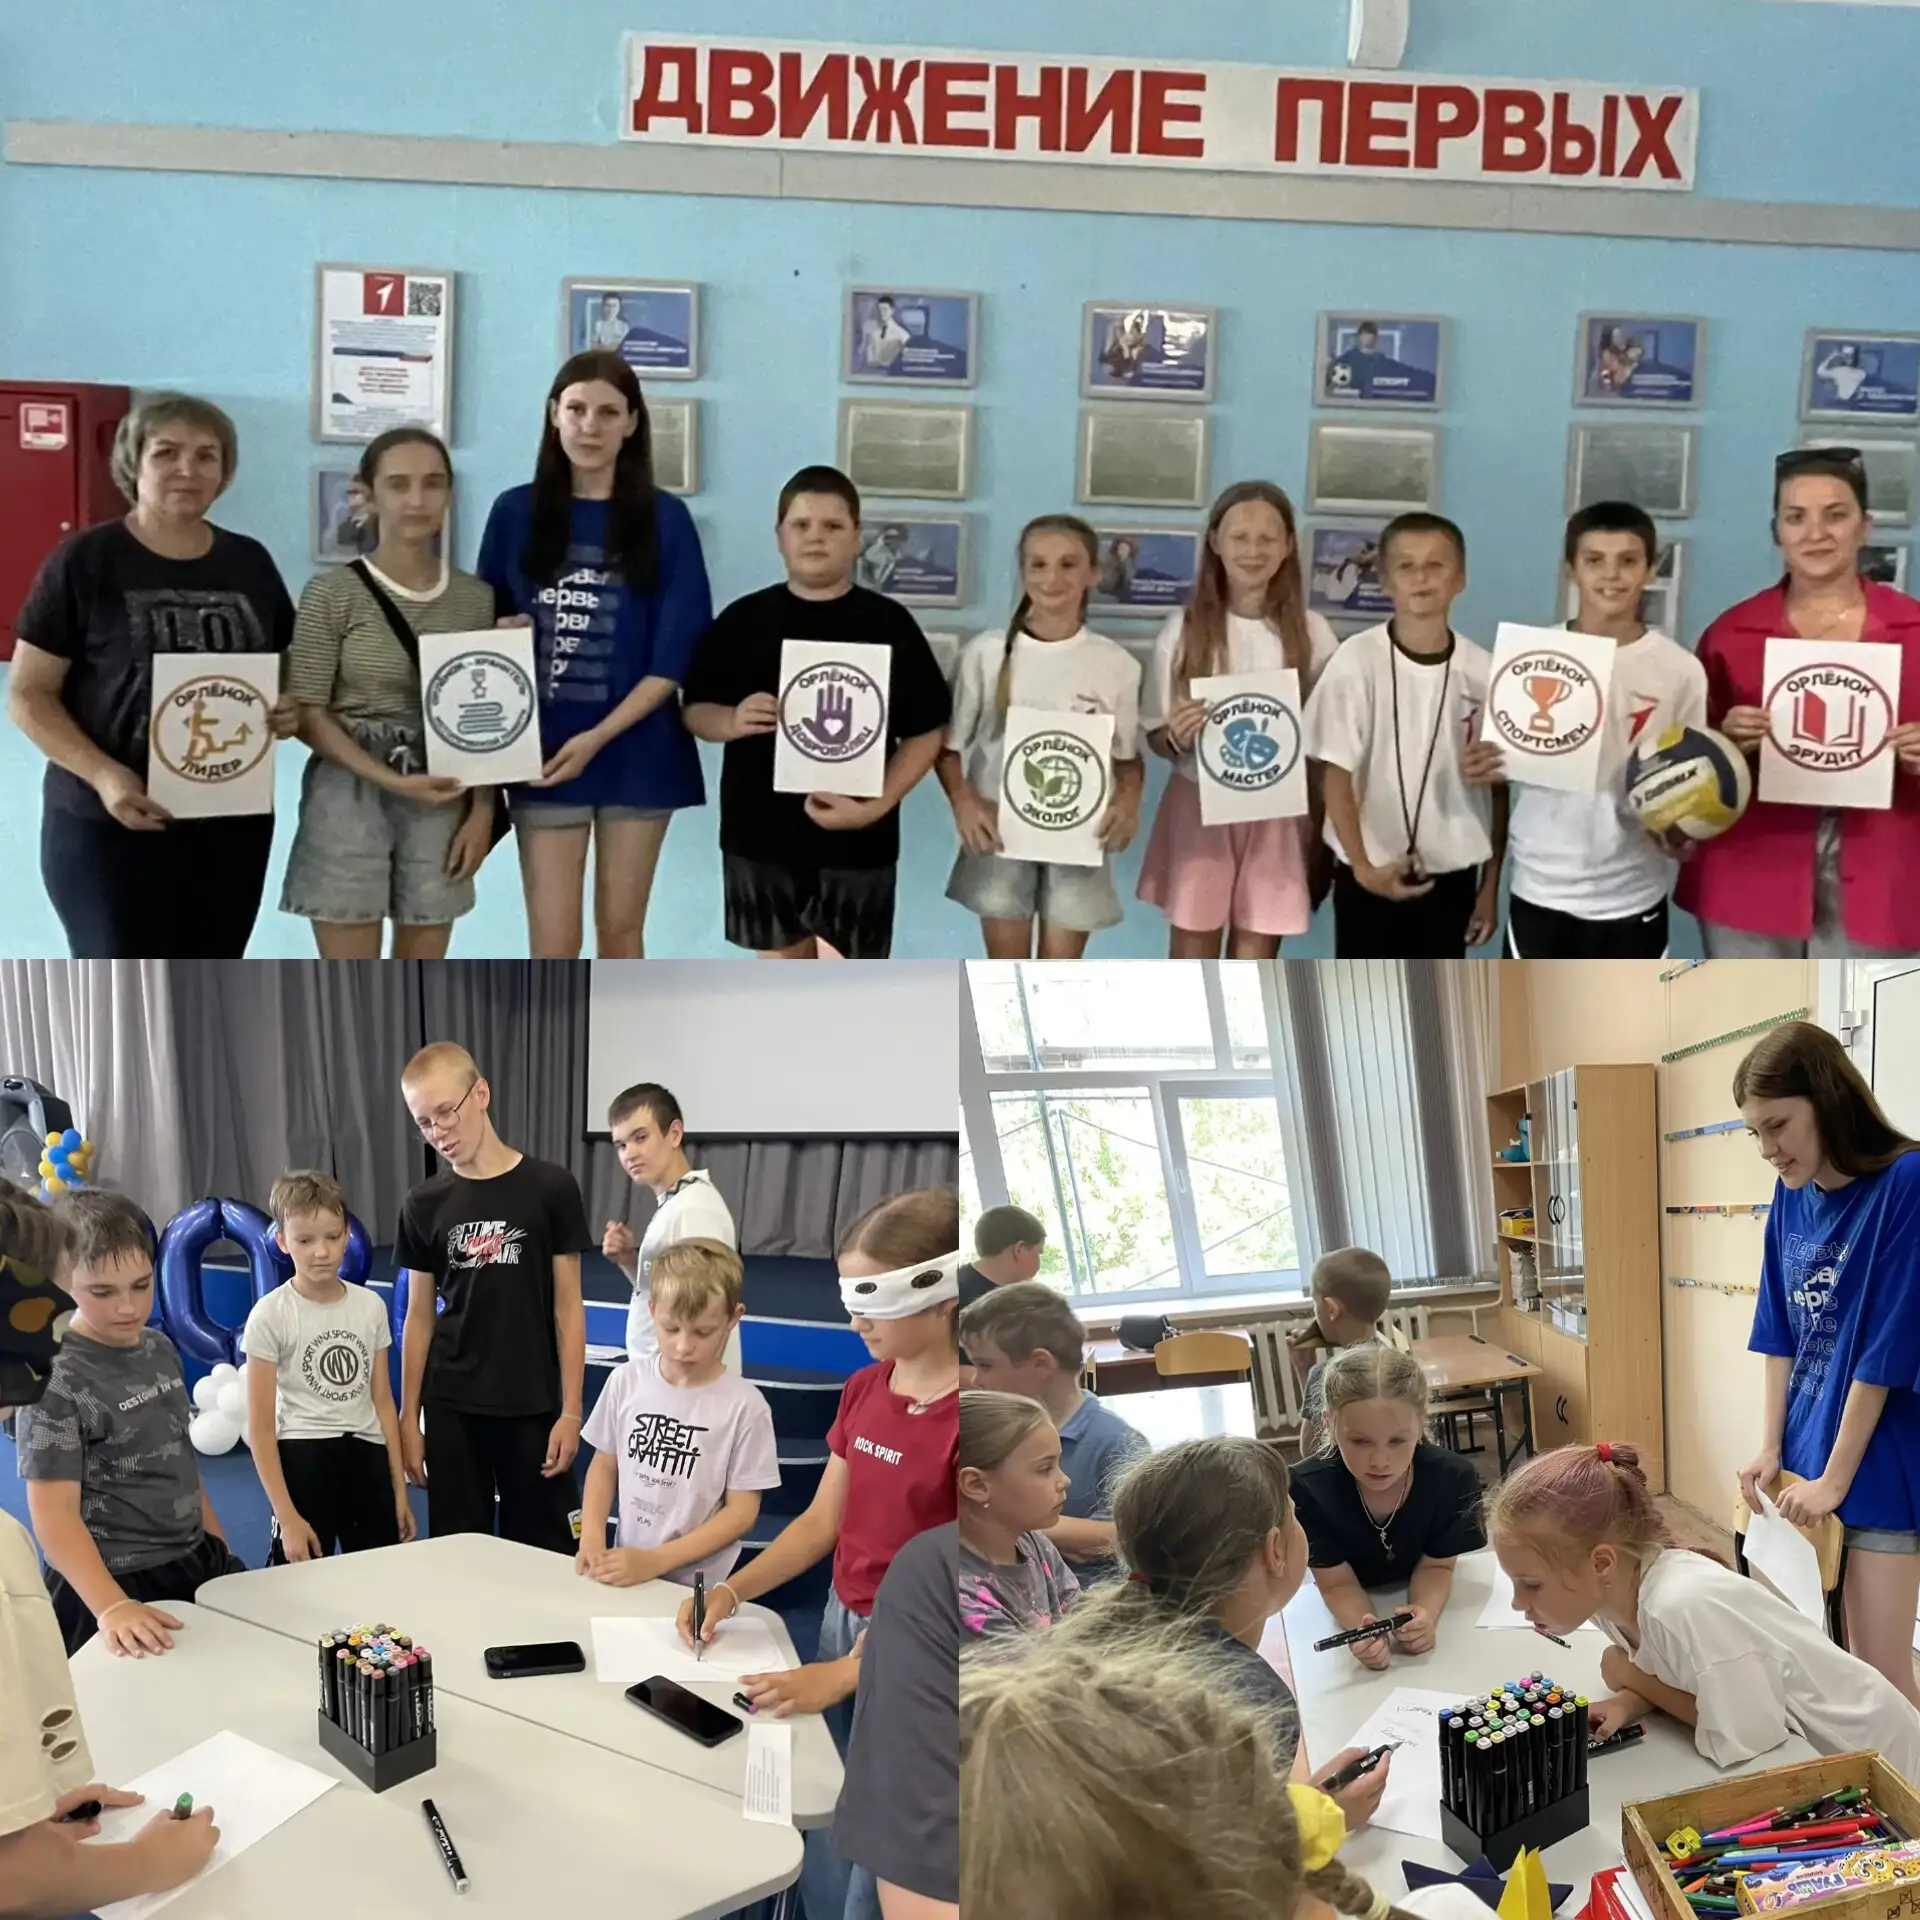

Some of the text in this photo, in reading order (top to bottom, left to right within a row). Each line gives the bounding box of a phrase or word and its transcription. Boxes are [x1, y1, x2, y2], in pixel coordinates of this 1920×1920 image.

[633, 46, 1683, 179] ДВИЖЕНИЕ ПЕРВЫХ
[799, 668, 871, 693] ОРЛЁНОК
[1512, 656, 1589, 687] ОРЛЁНОК
[1787, 670, 1875, 698] ОРЛЁНОК
[175, 682, 257, 707] ОРЛЁНОК
[1212, 699, 1282, 725] ОРЛЁНОК
[790, 723, 873, 756] ДОБРОВОЛЕЦ
[1497, 709, 1590, 749] СПОРТСМЕН
[1022, 736, 1092, 763] ОРЛЁНОК
[1788, 744, 1863, 767] ЭРУДИТ
[181, 758, 242, 779] ЛИДЕР
[1221, 764, 1281, 785] МАСТЕР
[1023, 802, 1080, 824] ЭКОЛОГ
[332, 1329, 357, 1342] SPORT
[302, 1344, 316, 1372] SPORT
[320, 1389, 348, 1401] SPORT
[633, 1413, 709, 1450] STREET
[628, 1433, 701, 1479] GRAFFITI
[854, 1436, 903, 1465] ROCK SPIRIT
